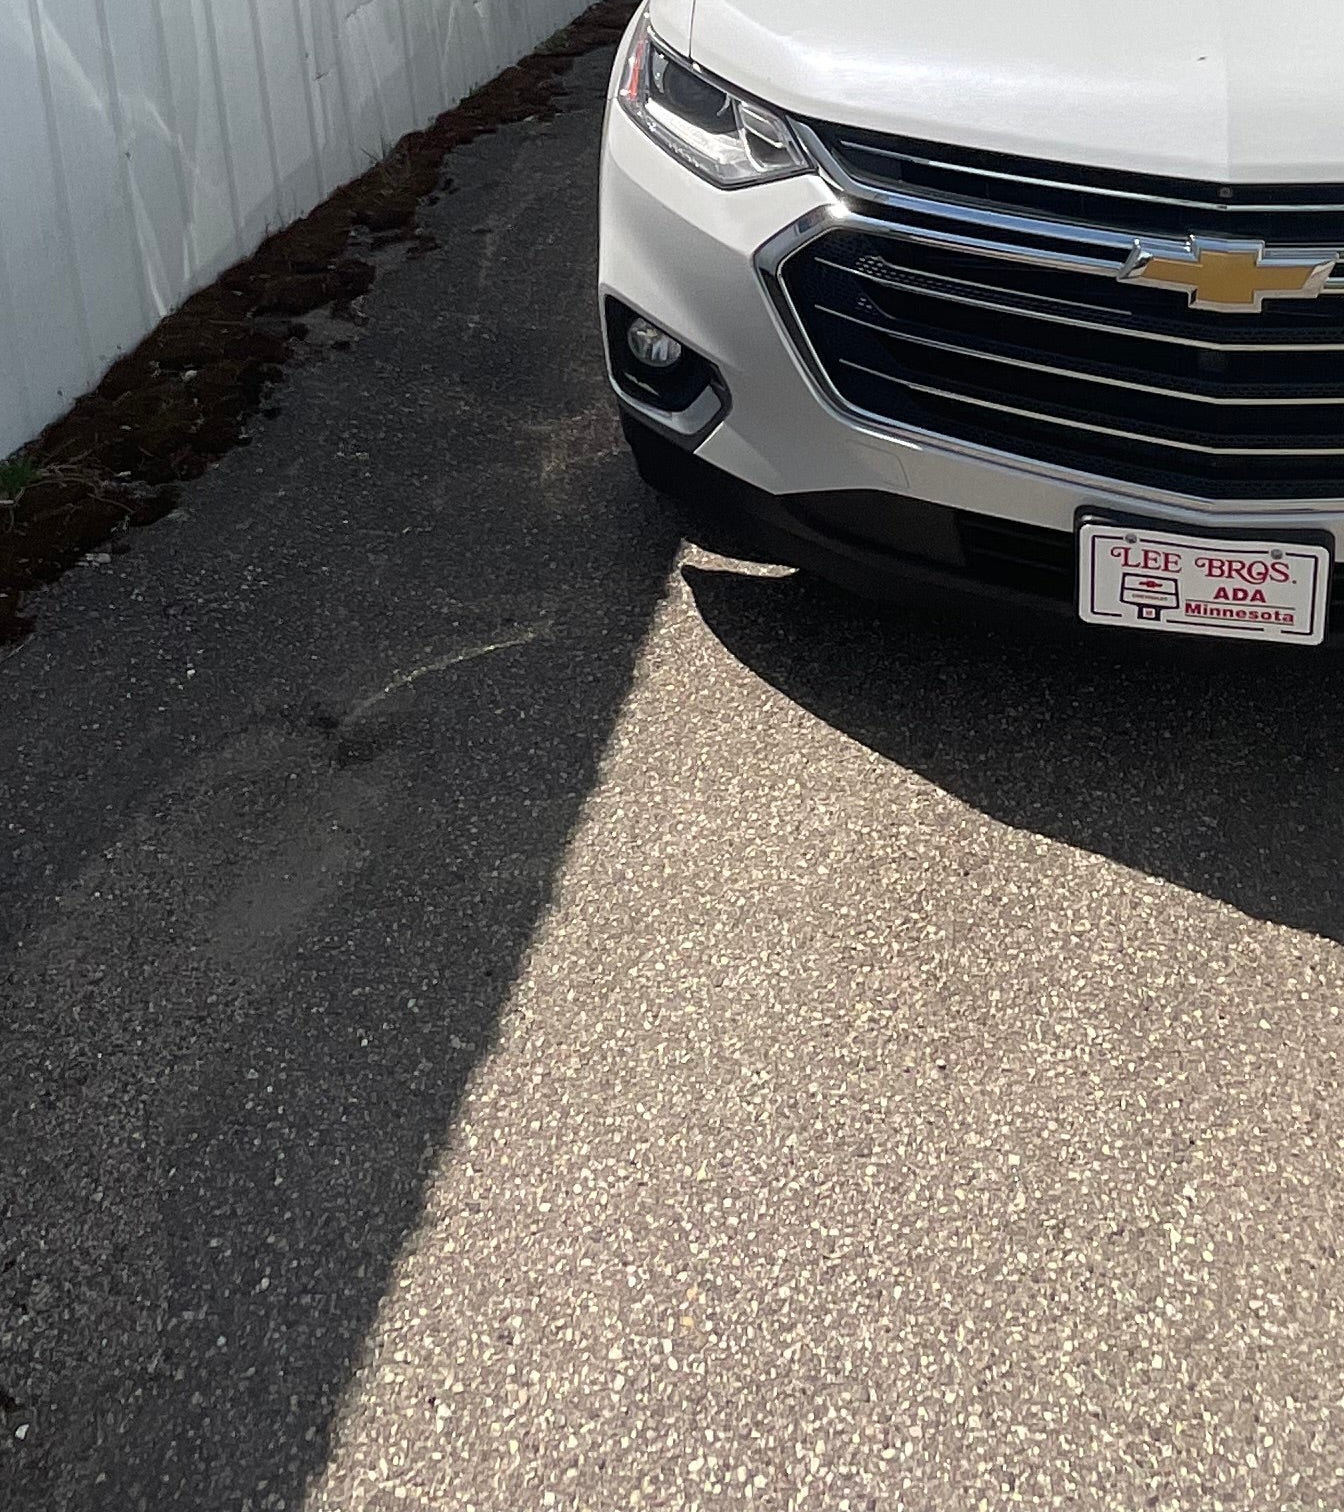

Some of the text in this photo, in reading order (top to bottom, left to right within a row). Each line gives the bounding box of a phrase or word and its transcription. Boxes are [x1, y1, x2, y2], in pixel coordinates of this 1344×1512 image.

[1110, 546, 1297, 585] LEE BROS.
[1213, 586, 1267, 604] ADA
[1184, 602, 1295, 624] Minnesota
